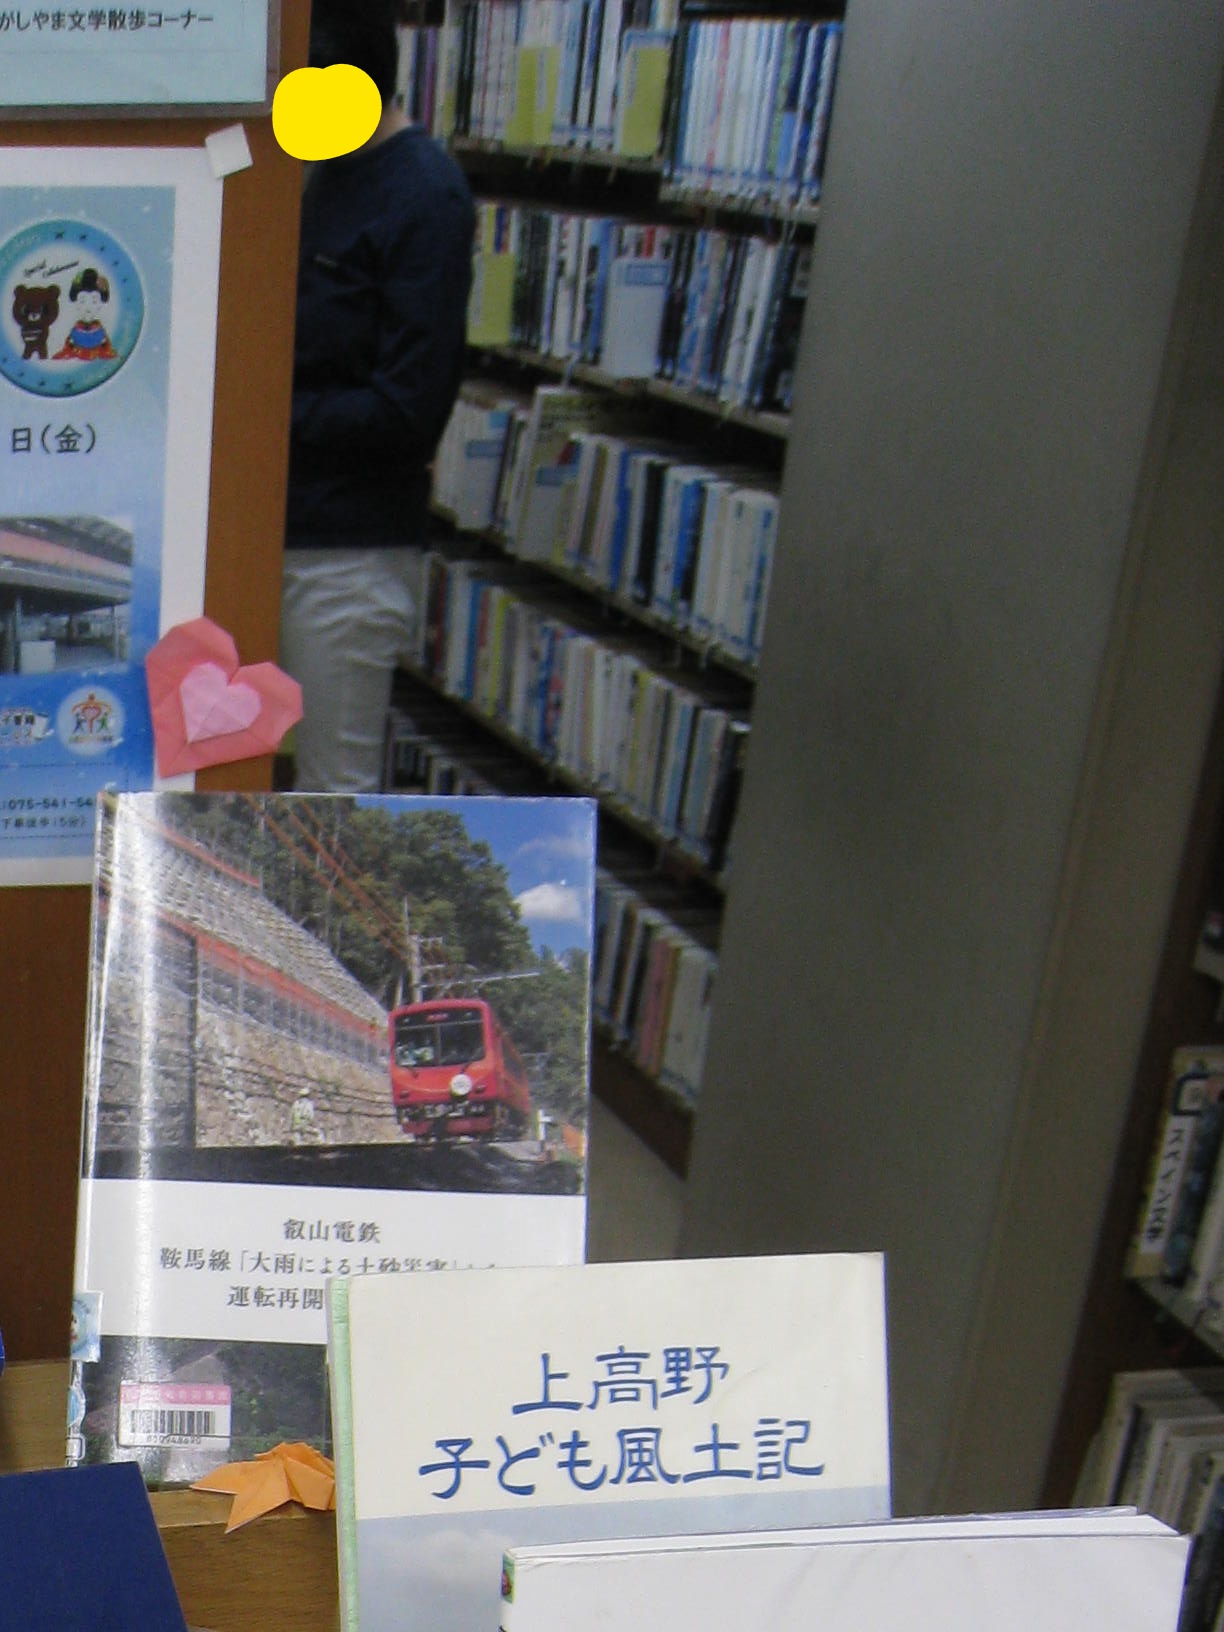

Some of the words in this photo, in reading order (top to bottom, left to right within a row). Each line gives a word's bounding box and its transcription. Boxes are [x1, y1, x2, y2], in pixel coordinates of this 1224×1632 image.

[283, 1218, 382, 1245] 叡山電鉄
[227, 1284, 324, 1310] 運転再開
[512, 1345, 729, 1415] 上高野
[419, 1418, 824, 1499] 子ども風土記
